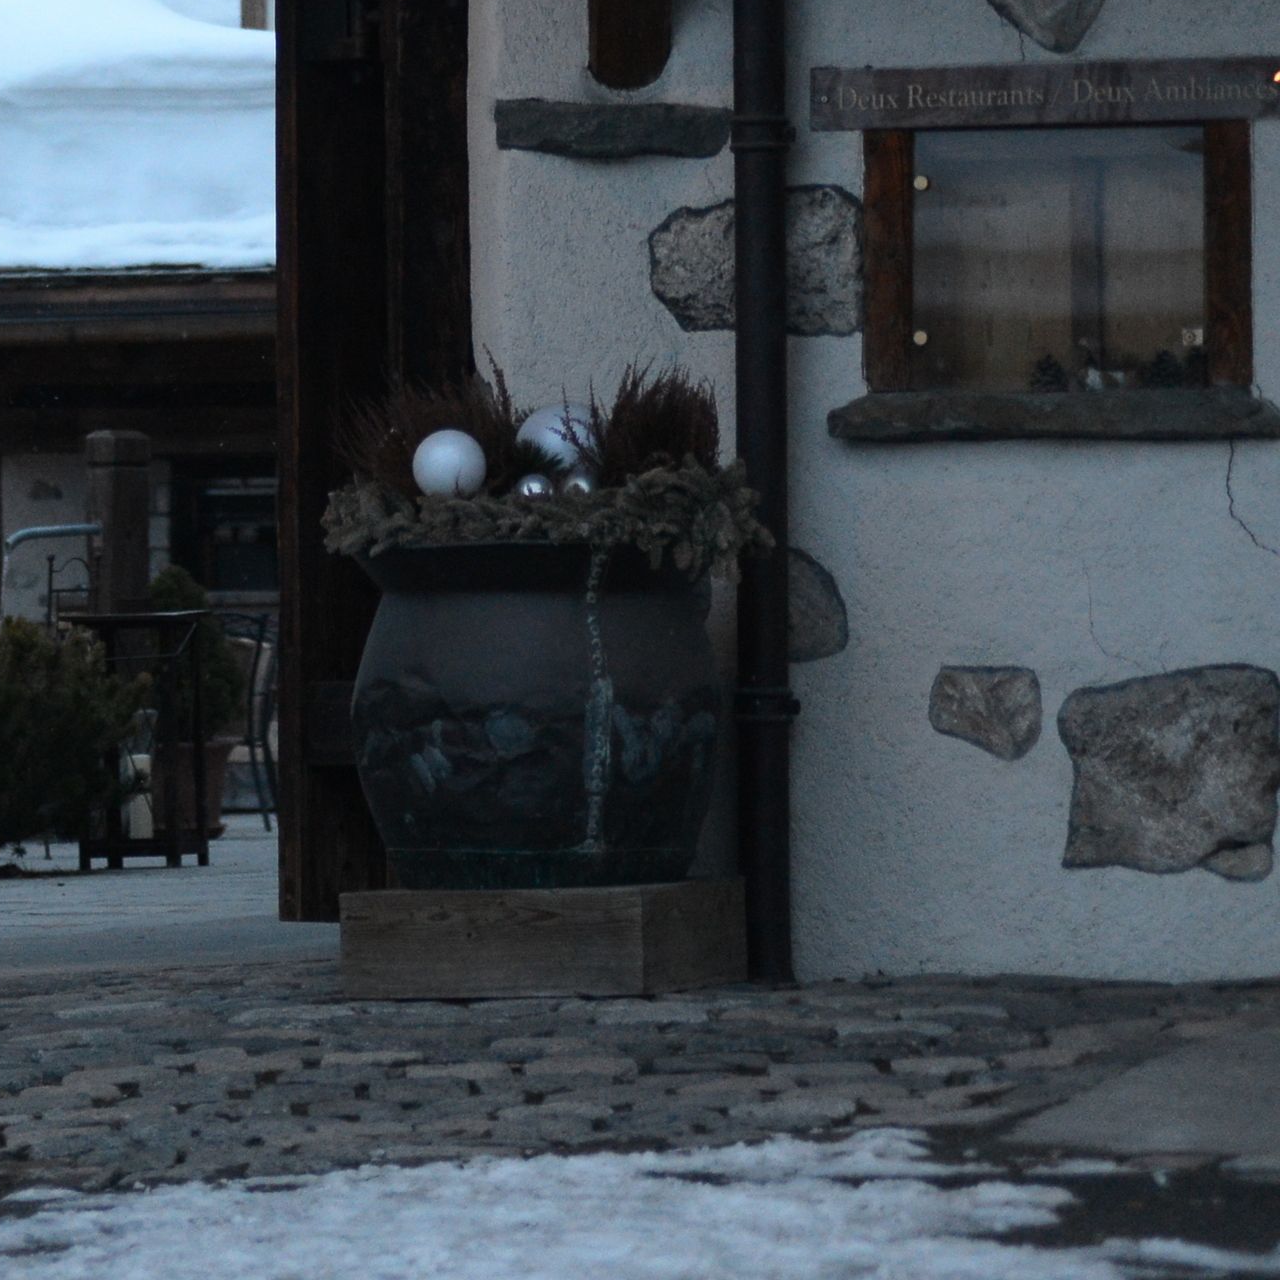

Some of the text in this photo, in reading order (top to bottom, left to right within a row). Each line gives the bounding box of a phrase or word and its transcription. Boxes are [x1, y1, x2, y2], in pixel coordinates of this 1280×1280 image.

[838, 86, 899, 111] Deux
[907, 84, 1044, 110] Restaurants
[1072, 78, 1135, 105] Deux
[1144, 75, 1279, 102] Ambiances
